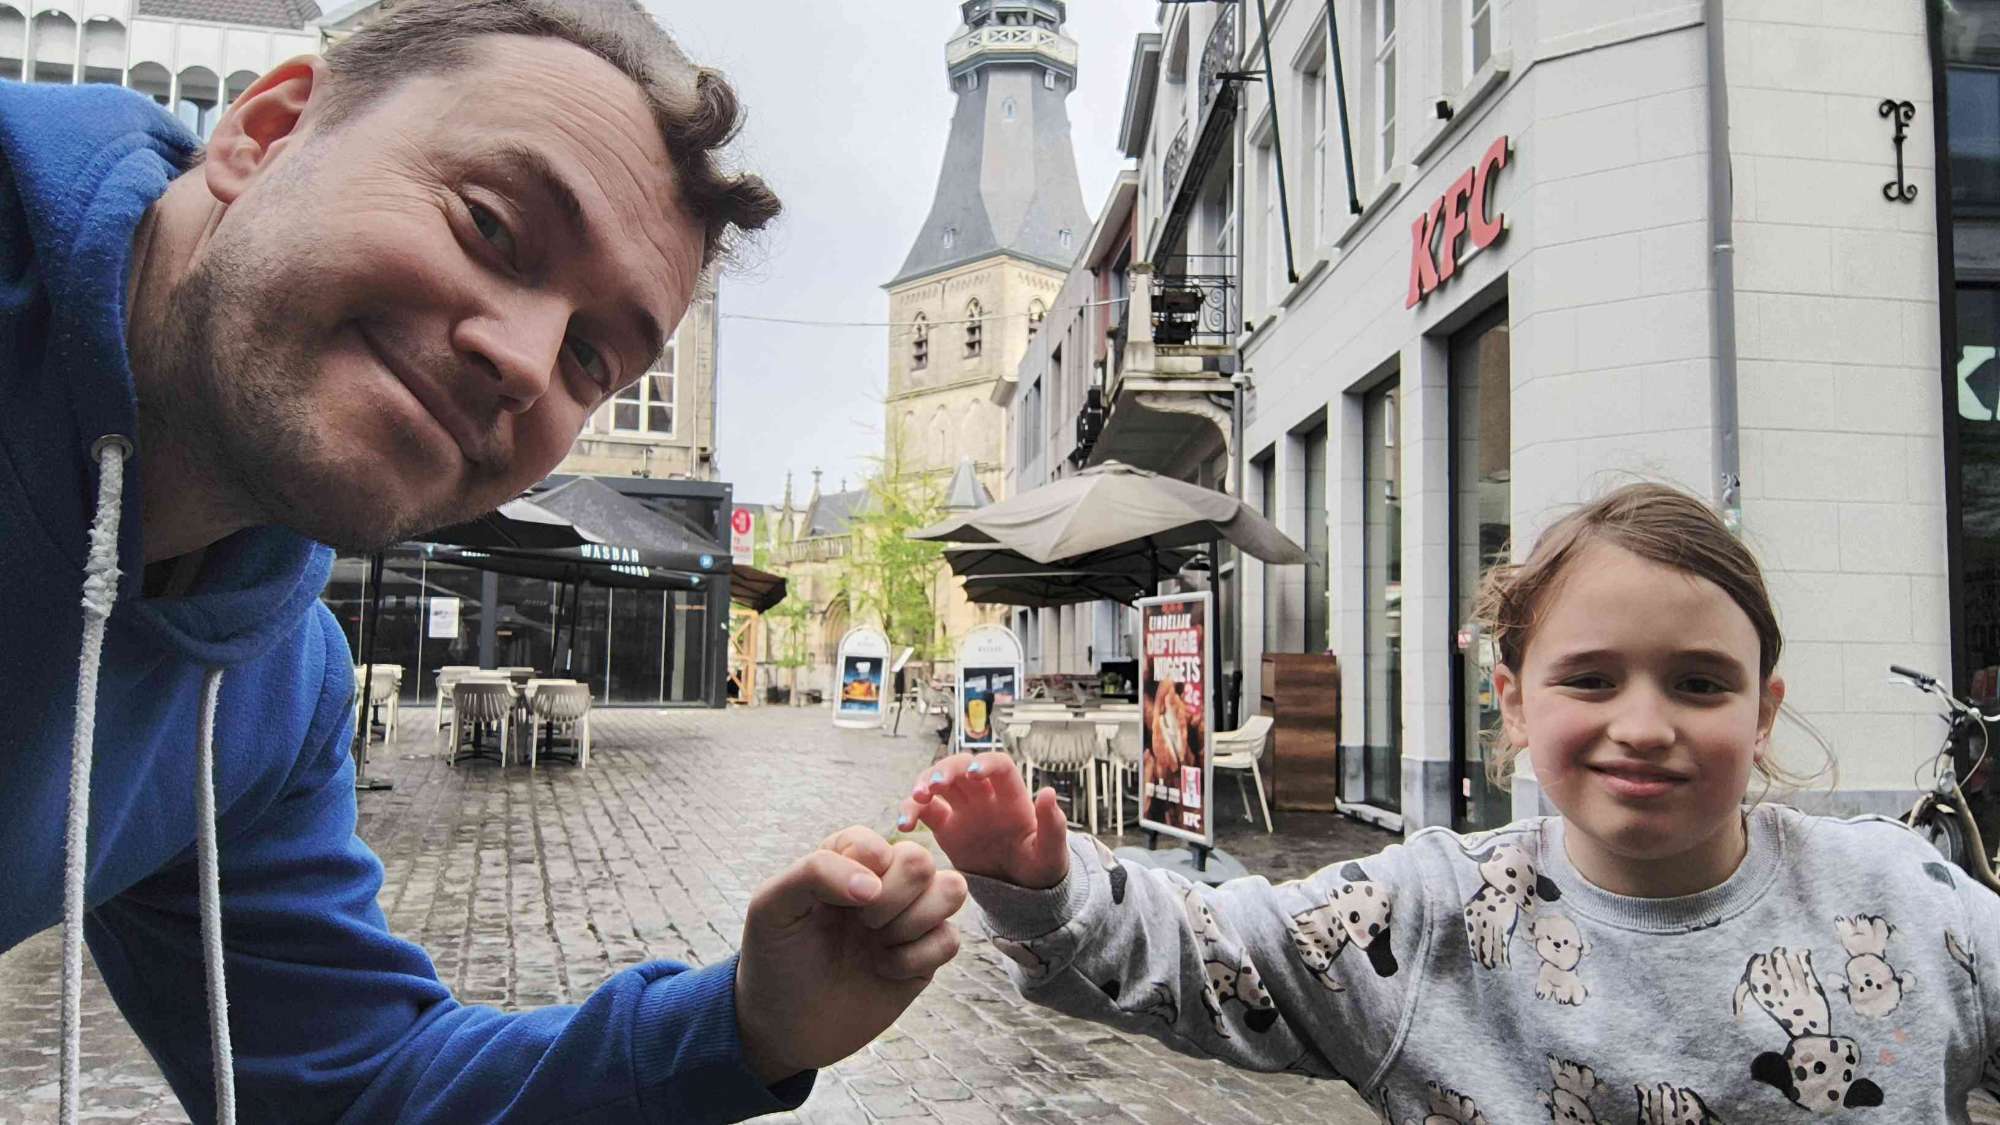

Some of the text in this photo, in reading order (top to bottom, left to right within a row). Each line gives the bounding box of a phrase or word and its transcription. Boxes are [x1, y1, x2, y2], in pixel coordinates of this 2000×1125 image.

[1405, 135, 1510, 311] KFC
[580, 543, 640, 563] WASBAR
[1146, 630, 1199, 656] DEFTIGE
[1153, 656, 1201, 684] NUGGETS
